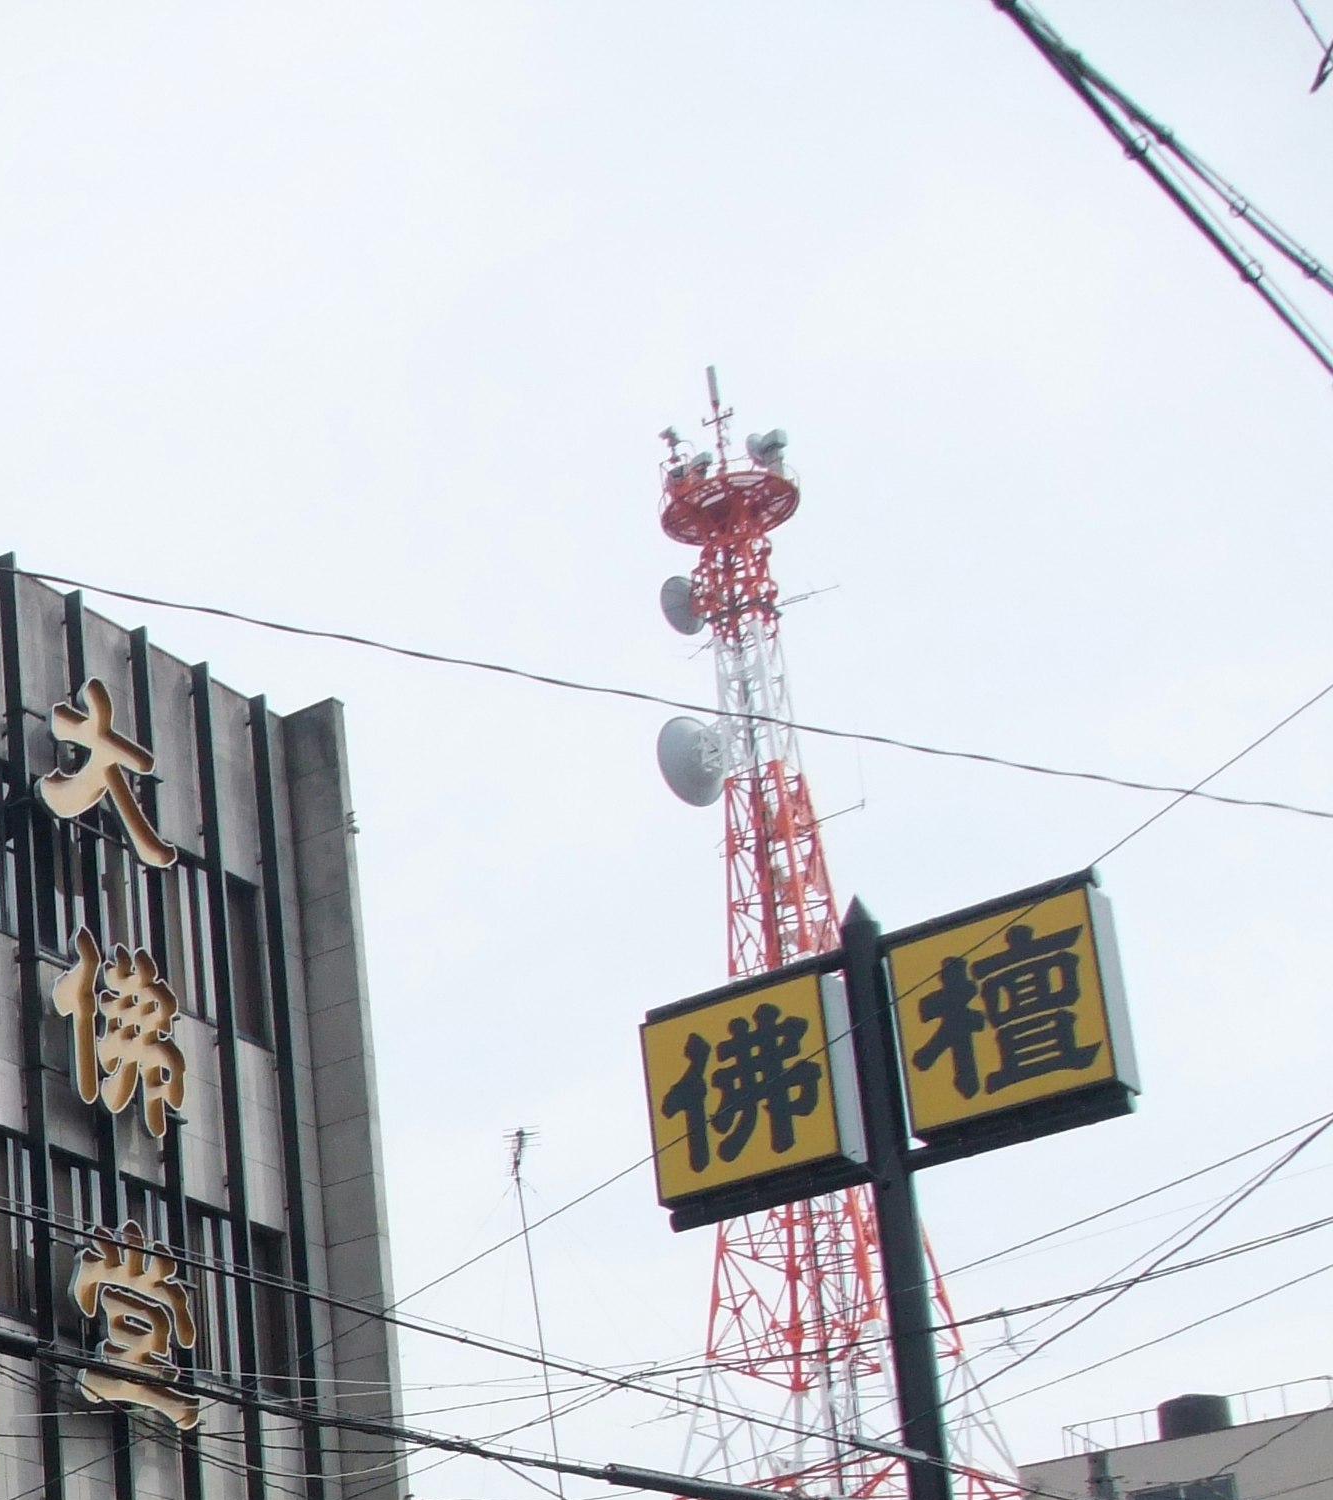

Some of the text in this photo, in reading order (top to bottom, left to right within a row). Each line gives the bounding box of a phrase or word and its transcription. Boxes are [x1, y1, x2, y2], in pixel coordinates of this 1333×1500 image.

[40, 676, 201, 1431] 大佛堂
[662, 1003, 822, 1173] 佛
